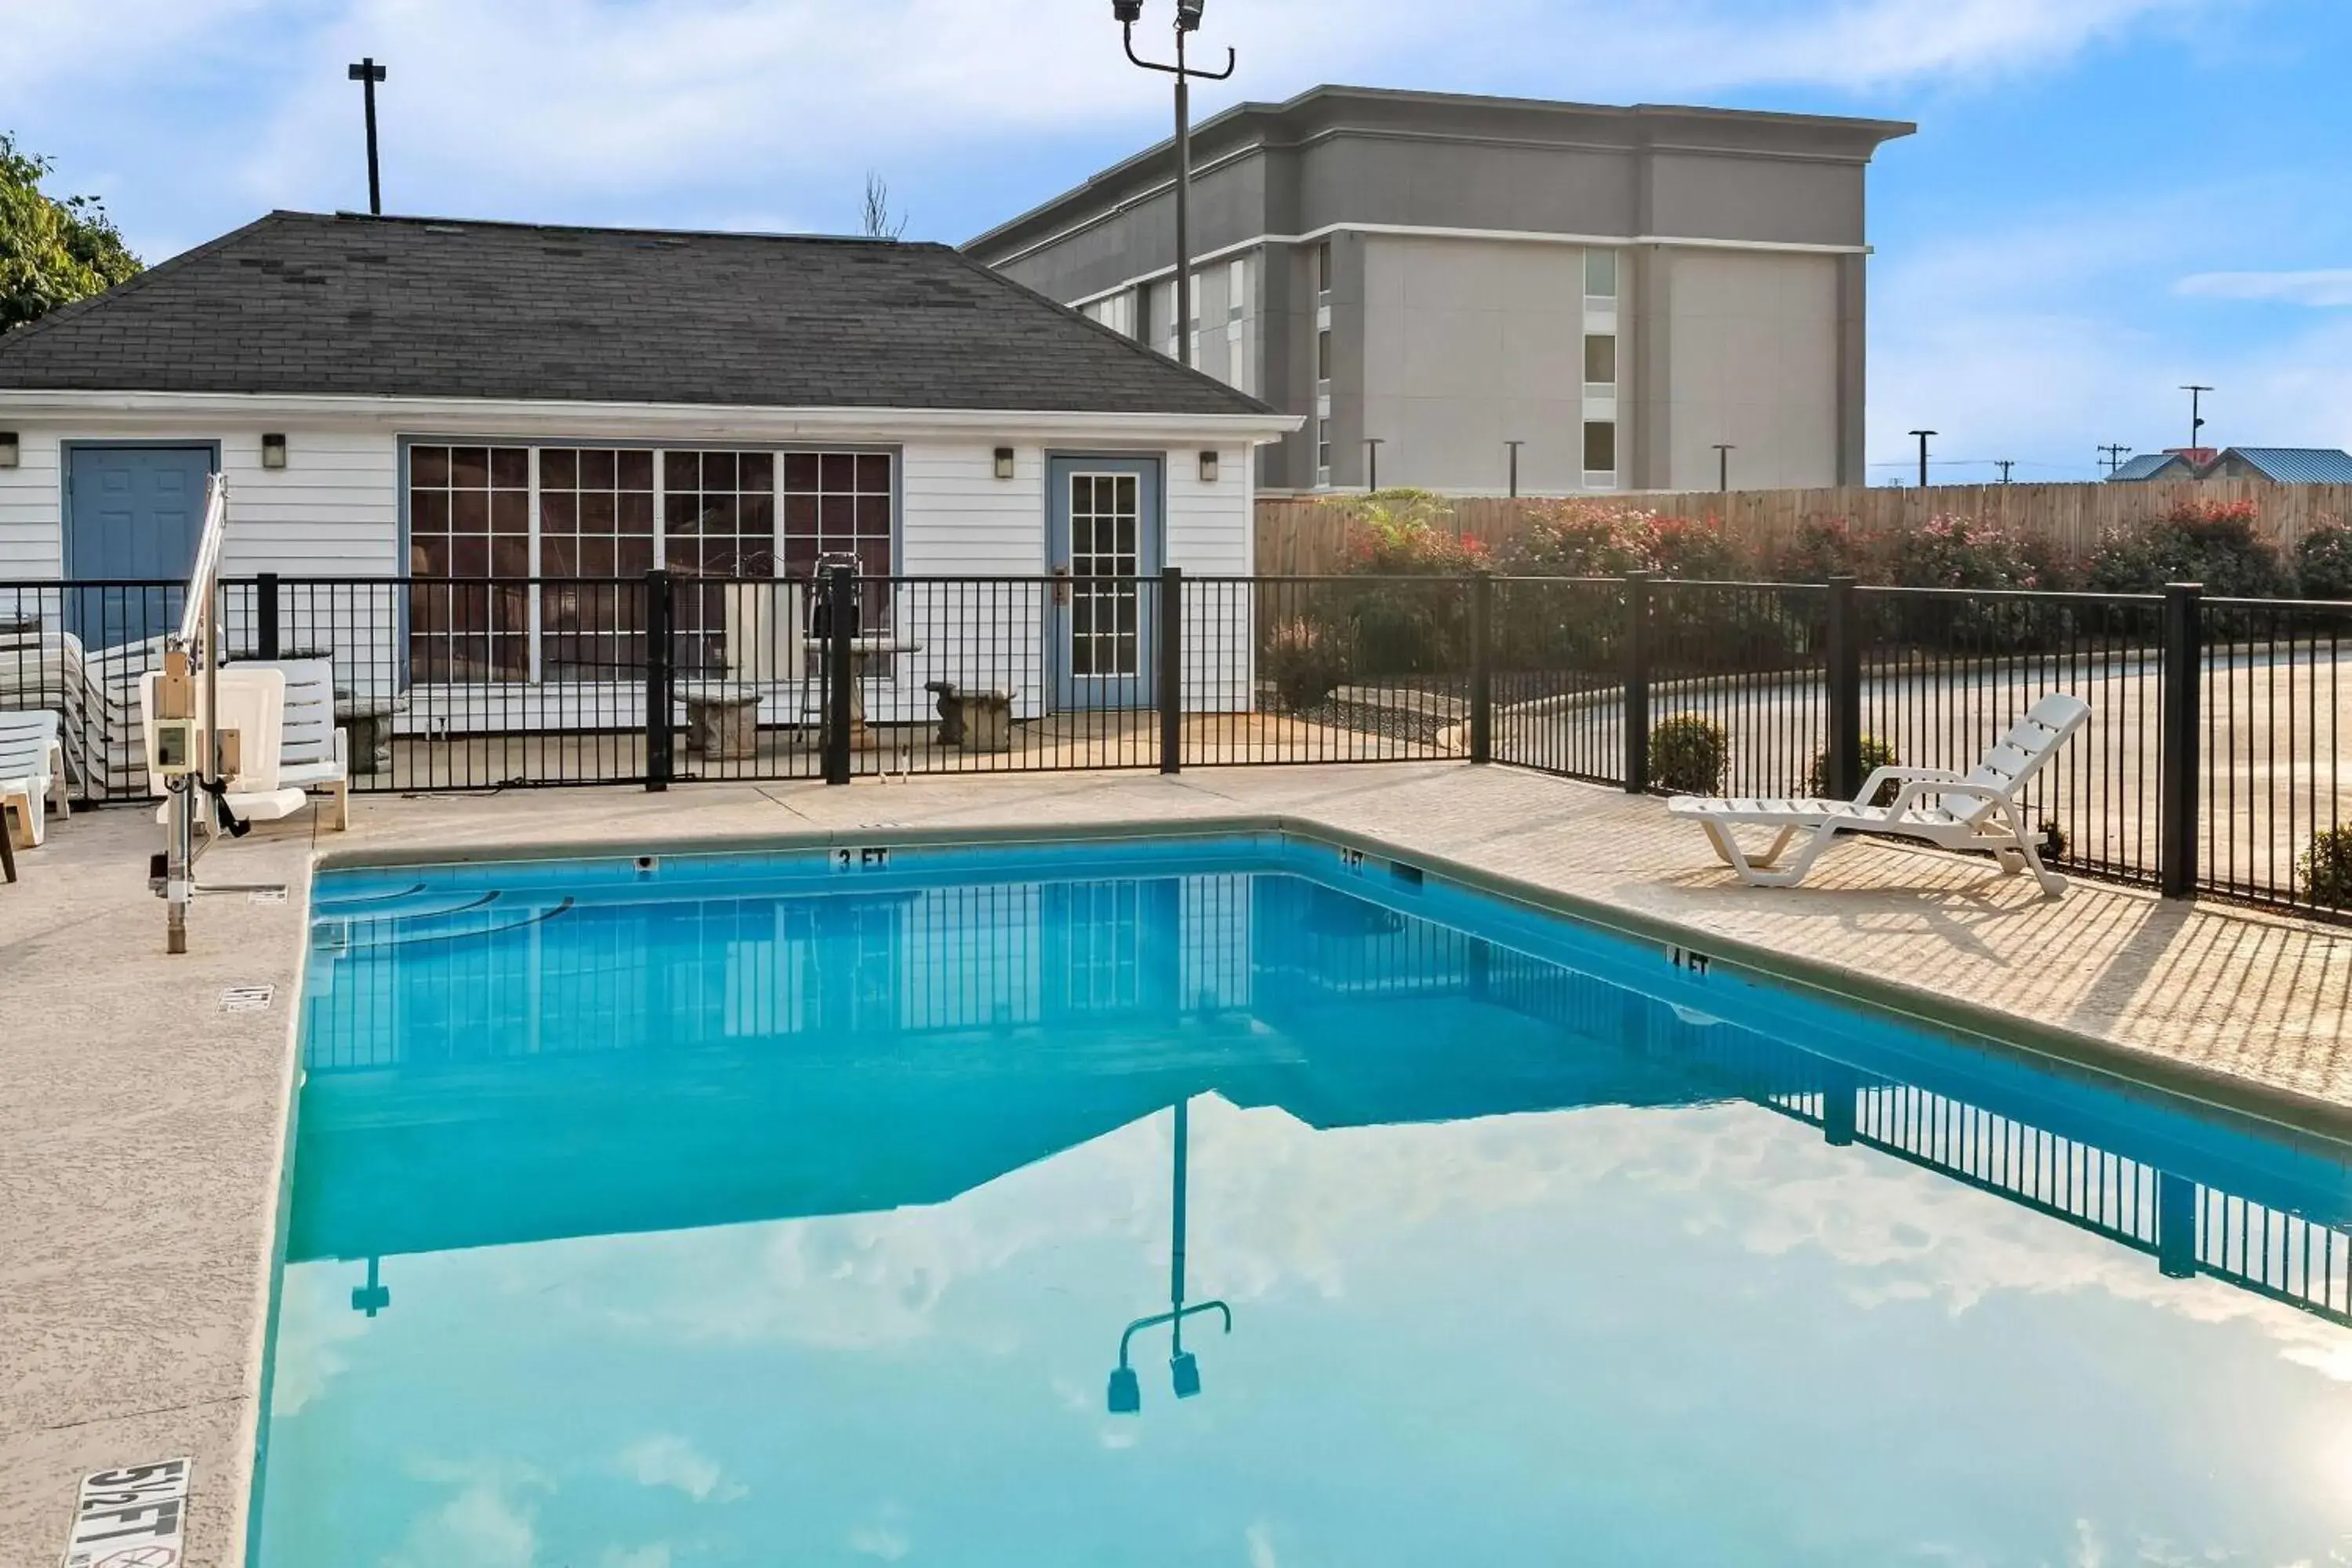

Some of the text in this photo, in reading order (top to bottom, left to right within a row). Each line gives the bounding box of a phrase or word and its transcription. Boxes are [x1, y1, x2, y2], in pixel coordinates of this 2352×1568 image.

[862, 848, 887, 864] FT
[1689, 951, 1709, 975] FT
[76, 1500, 180, 1544] FT
